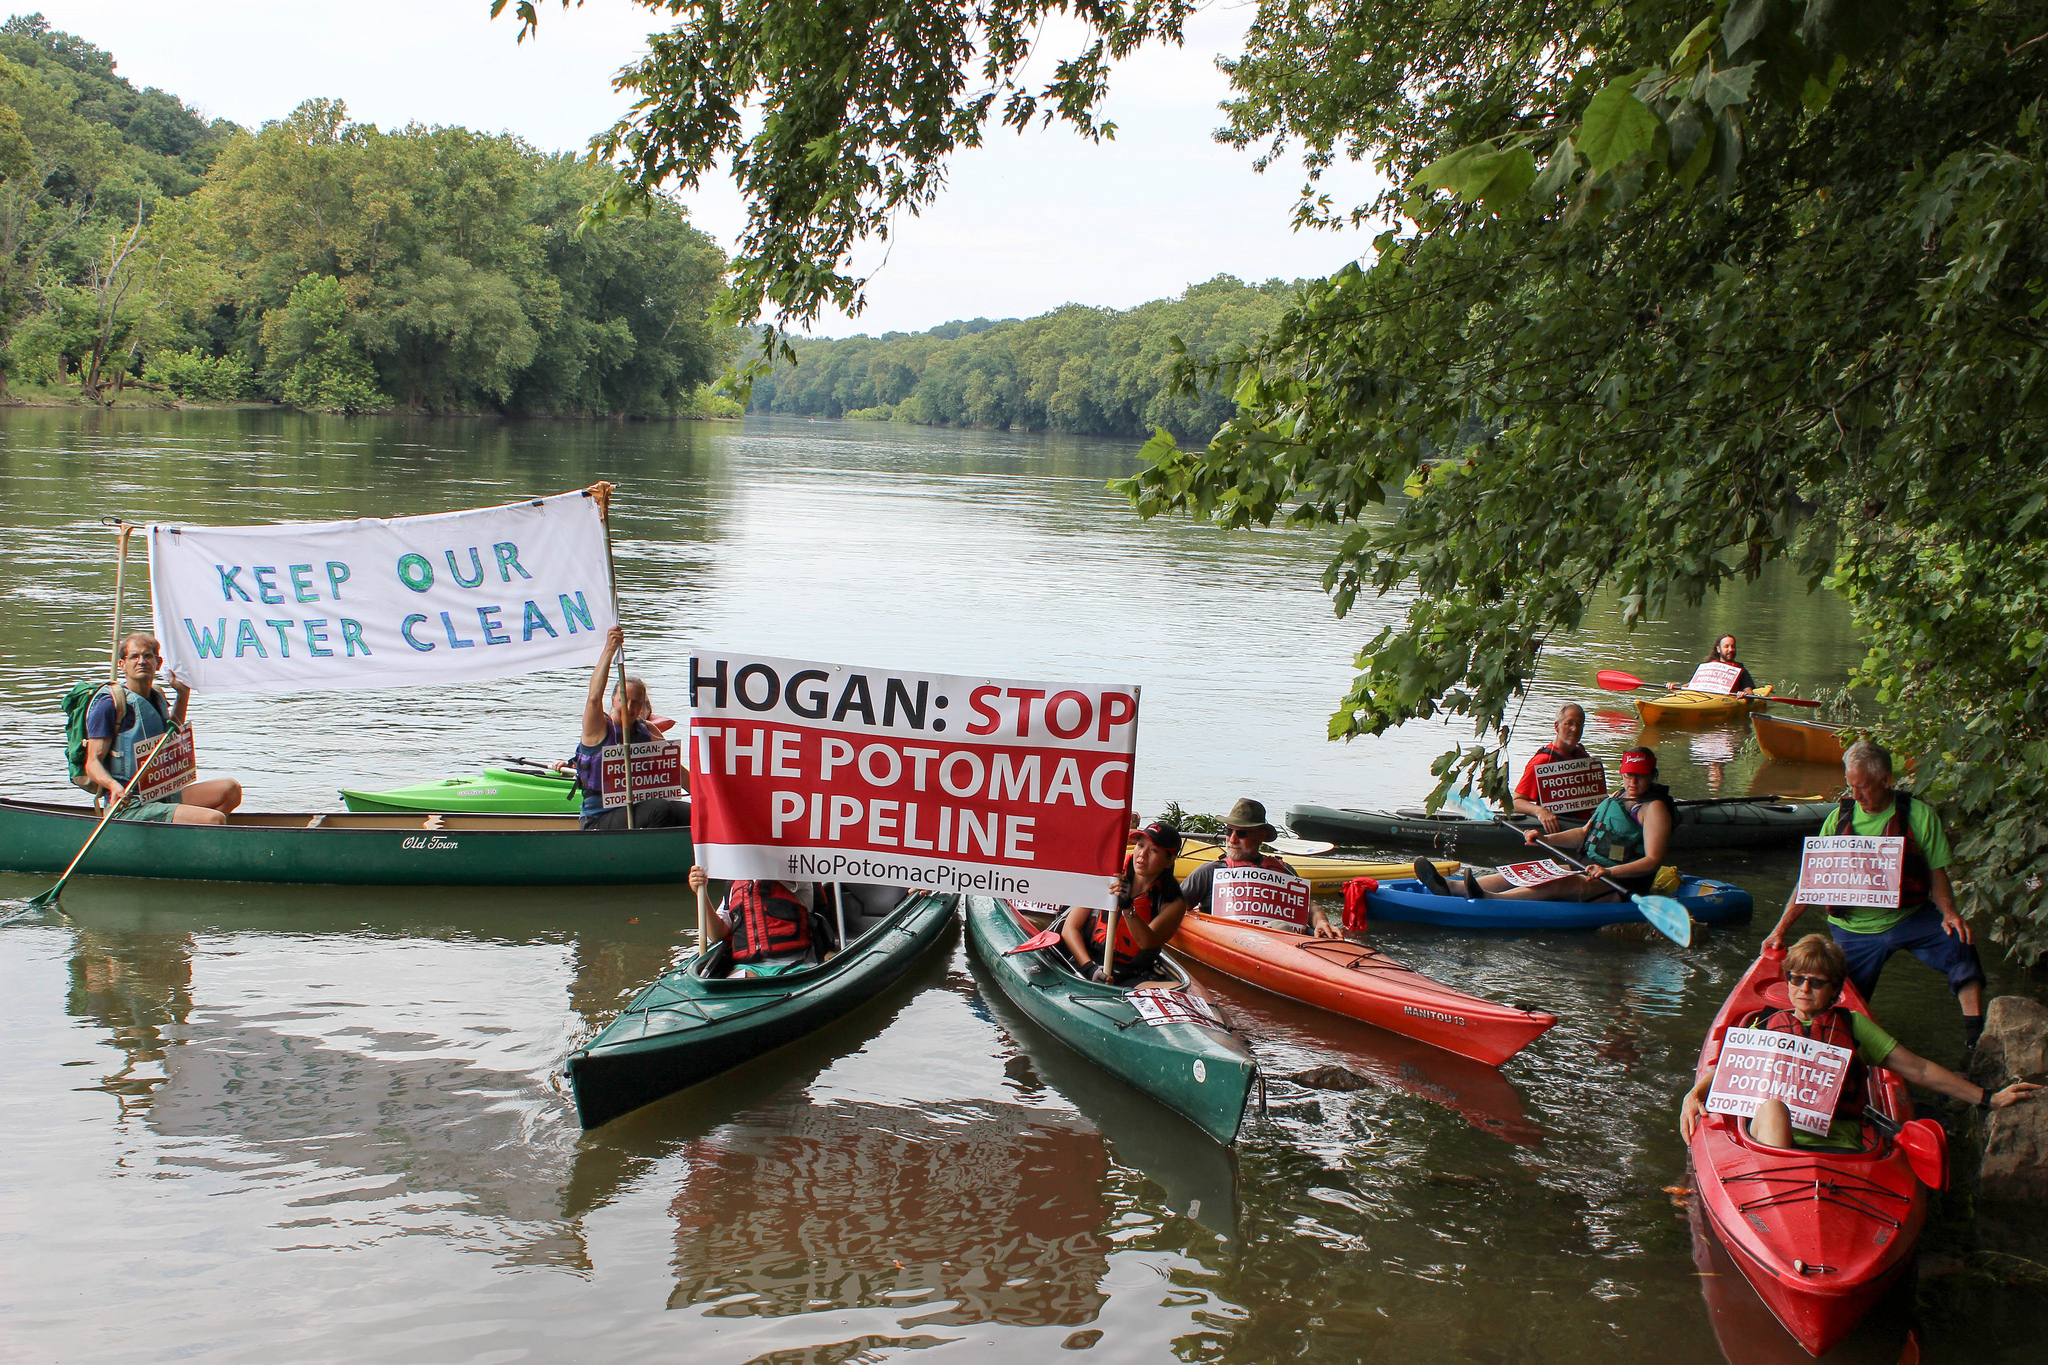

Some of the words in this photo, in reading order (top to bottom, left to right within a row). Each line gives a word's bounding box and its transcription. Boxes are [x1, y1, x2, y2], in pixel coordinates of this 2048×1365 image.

[216, 561, 351, 605] KEEP
[397, 542, 532, 593] OUR
[184, 618, 373, 659] WATER
[401, 591, 595, 652] CLEAN
[690, 657, 949, 732] HOGAN:
[965, 685, 1137, 743] STOP
[136, 742, 154, 755] GOV.
[178, 741, 192, 756] THE
[604, 749, 625, 758] GOV.
[148, 757, 189, 784] POTOMAC!
[657, 758, 677, 770] THE
[691, 726, 802, 778] THE
[820, 737, 1129, 810] POTOMAC
[1536, 765, 1557, 775] GOV.
[1558, 762, 1588, 772] HOGAN:
[1542, 774, 1585, 789] PROTECT
[1586, 771, 1602, 783] THE
[142, 789, 159, 803] STOP
[160, 782, 173, 795] THE
[605, 795, 627, 806] STOP
[646, 789, 681, 801] PIPELINE
[1550, 784, 1599, 799] POTOMAC!
[1565, 801, 1580, 810] THE
[771, 791, 1036, 861] PIPELINE
[402, 836, 428, 850] Old
[428, 835, 459, 850] Town
[1806, 841, 1829, 850] GOV.
[1832, 839, 1876, 850] HOGAN:
[1808, 857, 1867, 869] PROTECT
[1870, 858, 1896, 870] THE
[787, 853, 1030, 895] #NoPotomacPipeline
[1216, 870, 1239, 881] GOV.
[1242, 871, 1285, 885] HOGAN:
[1813, 873, 1886, 886] POTOMAC!
[1218, 886, 1278, 900] PROTECT
[1279, 892, 1304, 907] THE
[1799, 892, 1826, 902] STOP
[1827, 893, 1847, 902] THE
[1849, 893, 1899, 905] PIPELINE
[1225, 902, 1295, 919] POTOMAC!
[1404, 1006, 1452, 1023] MANITOU
[1454, 1016, 1466, 1026] 13
[1728, 1032, 1755, 1046] GOV.
[1758, 1035, 1813, 1056] HOGAN:
[1725, 1053, 1798, 1077] PROTECT
[1800, 1065, 1836, 1088] THE
[1728, 1074, 1818, 1105] POTOMAC!
[1708, 1097, 1738, 1110] STOP
[1791, 1110, 1829, 1132] ELINE
